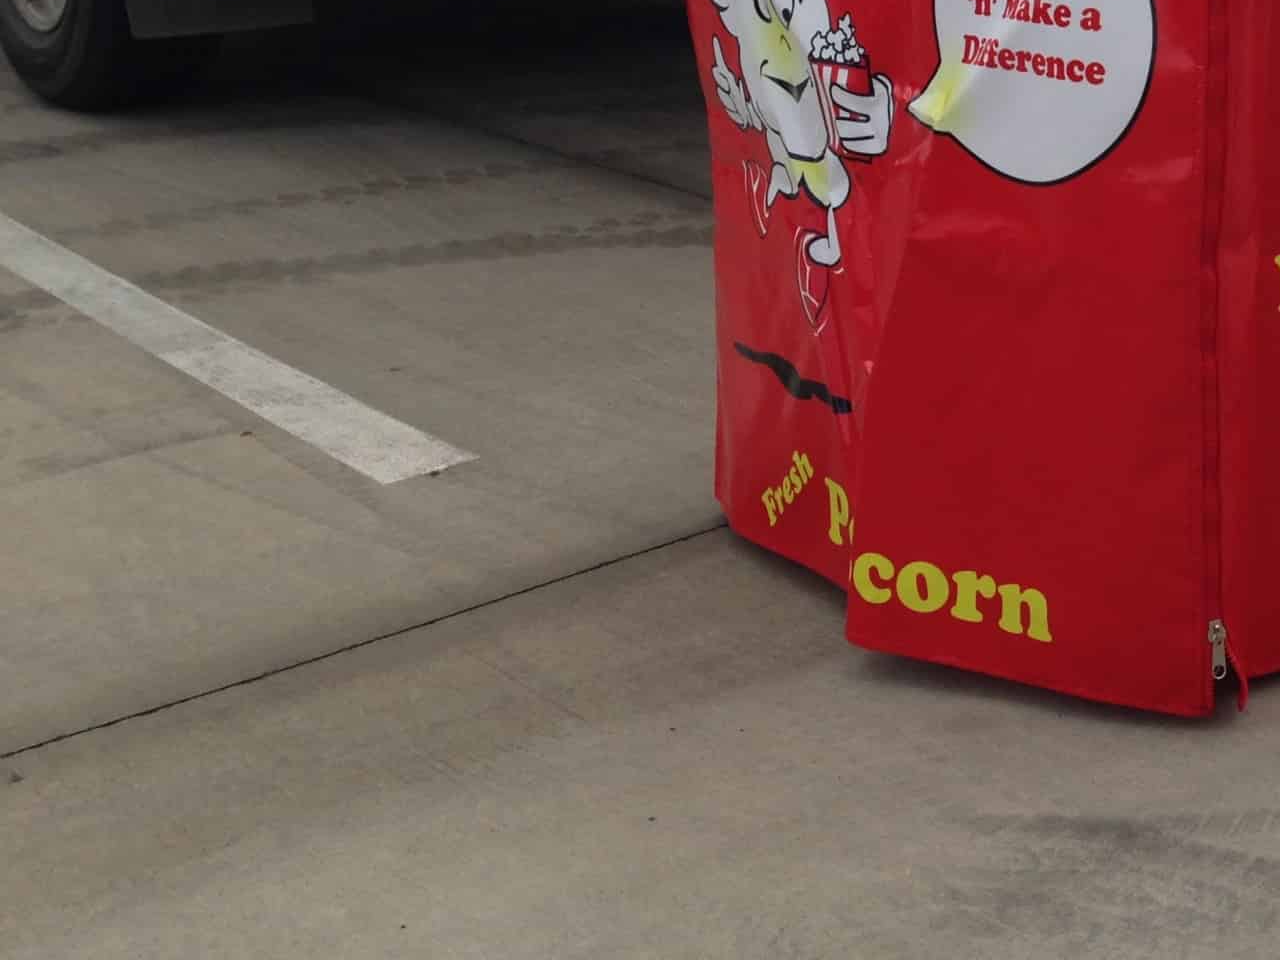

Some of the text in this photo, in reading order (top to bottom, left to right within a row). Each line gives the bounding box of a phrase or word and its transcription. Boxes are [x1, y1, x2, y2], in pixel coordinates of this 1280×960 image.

[1079, 6, 1102, 32] a
[961, 34, 1107, 86] Difference
[761, 450, 814, 527] Fresh
